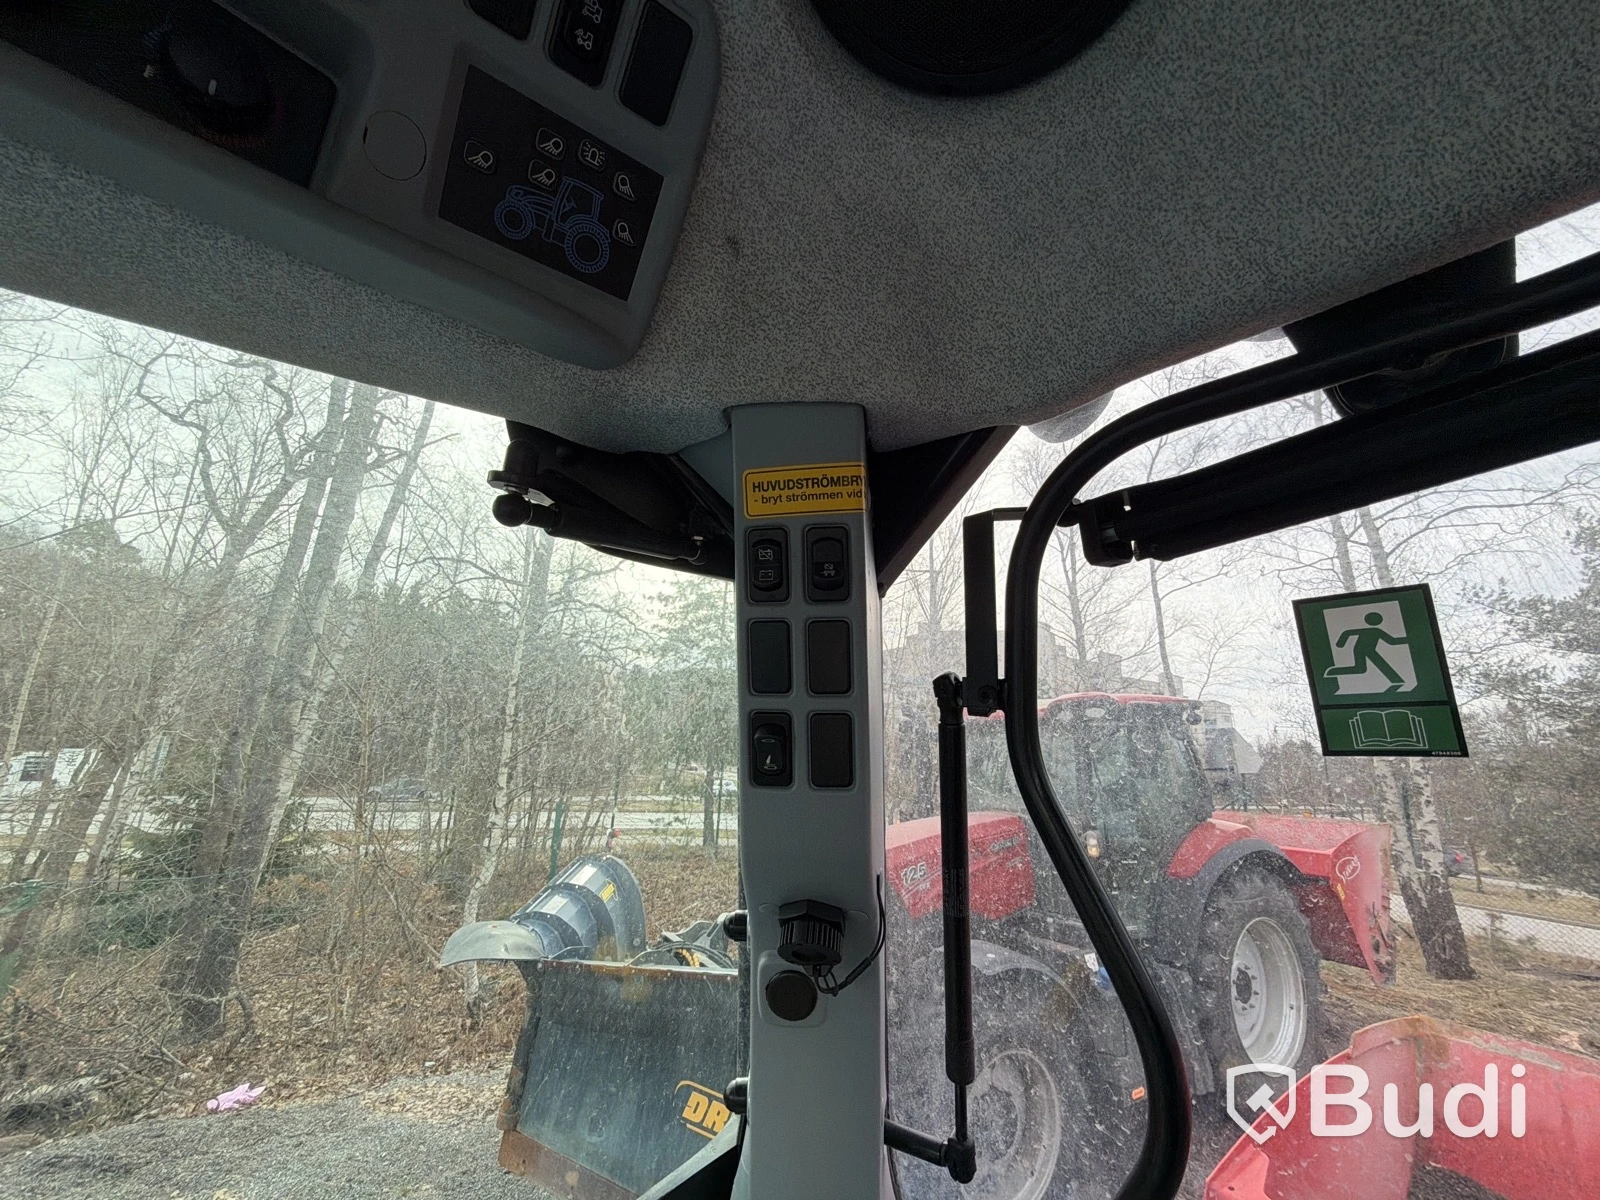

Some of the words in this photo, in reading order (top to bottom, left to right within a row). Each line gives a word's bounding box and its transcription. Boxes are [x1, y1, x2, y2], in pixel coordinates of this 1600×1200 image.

[761, 493, 783, 506] bryt
[785, 490, 844, 504] strömmen
[846, 488, 862, 499] vid
